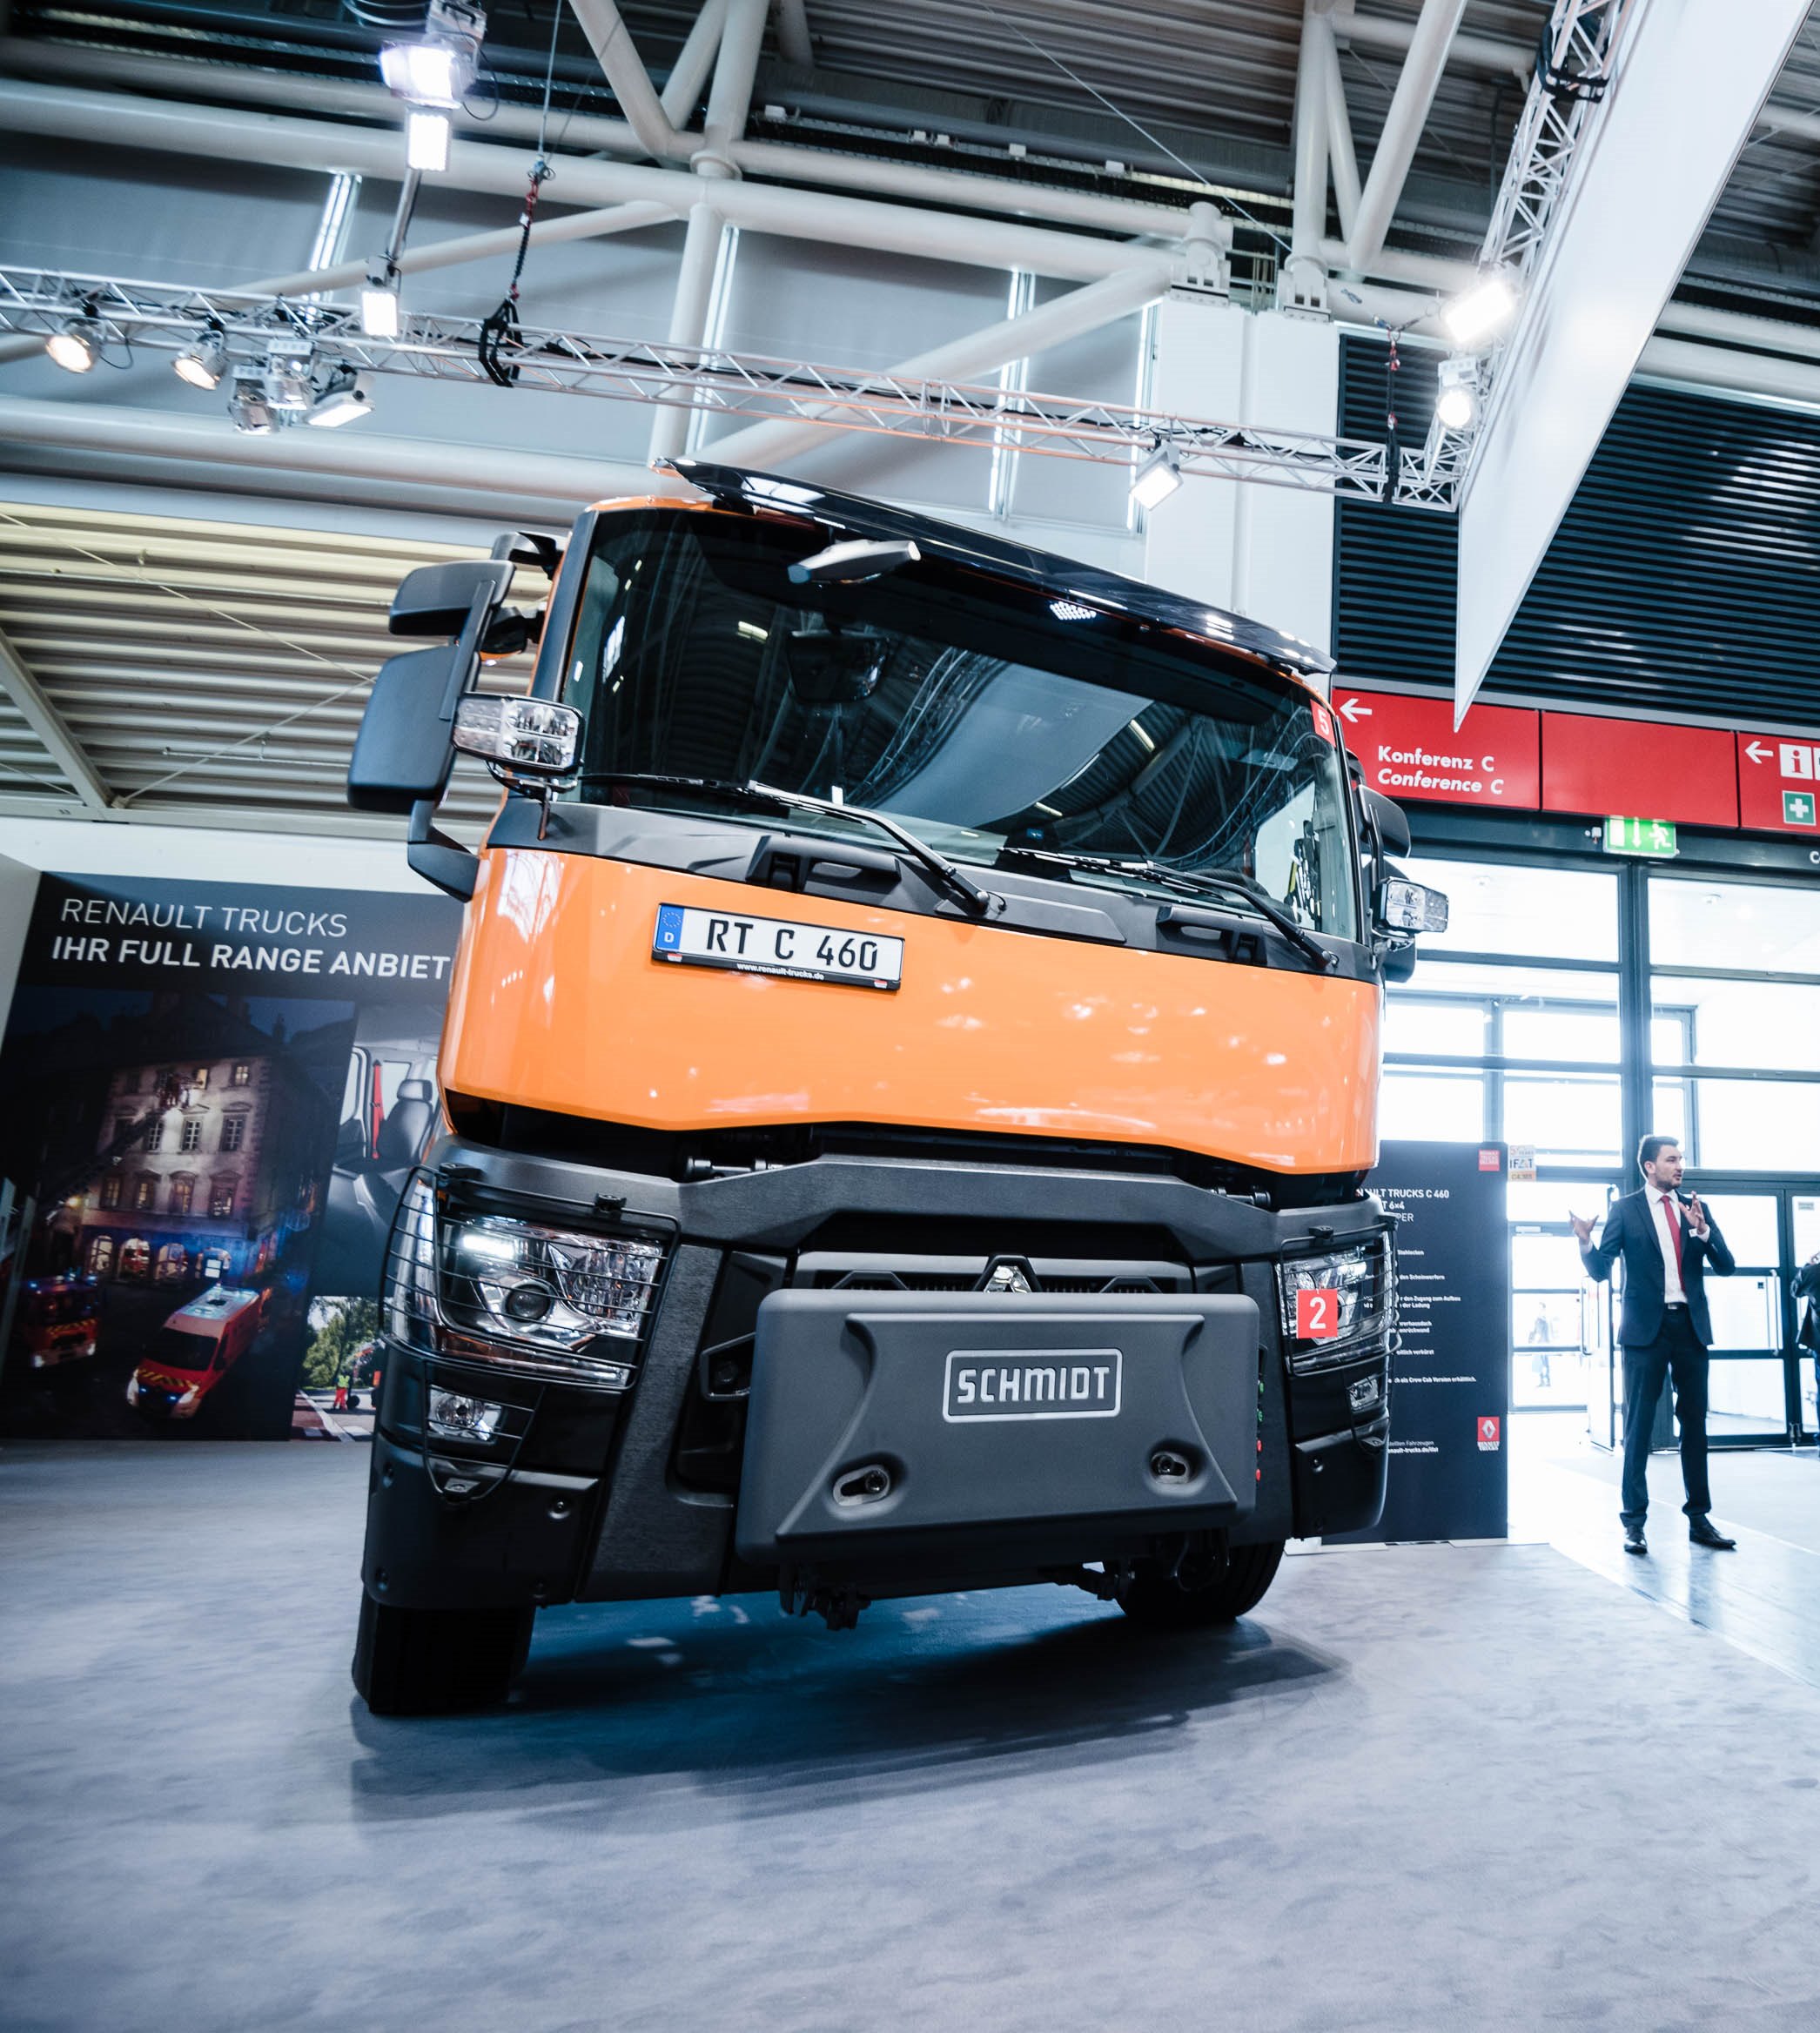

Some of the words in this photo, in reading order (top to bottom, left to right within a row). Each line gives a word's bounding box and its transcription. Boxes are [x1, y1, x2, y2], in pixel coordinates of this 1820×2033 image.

[1318, 708, 1330, 735] 5
[1378, 745, 1474, 770] Konferenz
[1481, 755, 1494, 772] C
[1378, 768, 1482, 793] Conference
[1490, 779, 1504, 795] C
[61, 898, 212, 929] RENAULT
[221, 906, 347, 937] TRUCKS
[664, 932, 675, 943] D
[707, 918, 754, 955] RT
[775, 929, 795, 960] C
[816, 935, 878, 971] 460
[52, 936, 110, 963] IHR
[118, 939, 200, 967] FULL
[211, 944, 324, 973] RANGE
[328, 950, 451, 980] ANBIET
[736, 963, 825, 981] www.renault-trucks.de
[1388, 1189, 1425, 1198] TRUCKS
[1426, 1190, 1433, 1198] C
[1434, 1190, 1450, 1199] 460
[1389, 1201, 1406, 1211] 6x4
[1309, 1297, 1326, 1330] 2
[957, 1366, 1110, 1404] SCHMIDT
